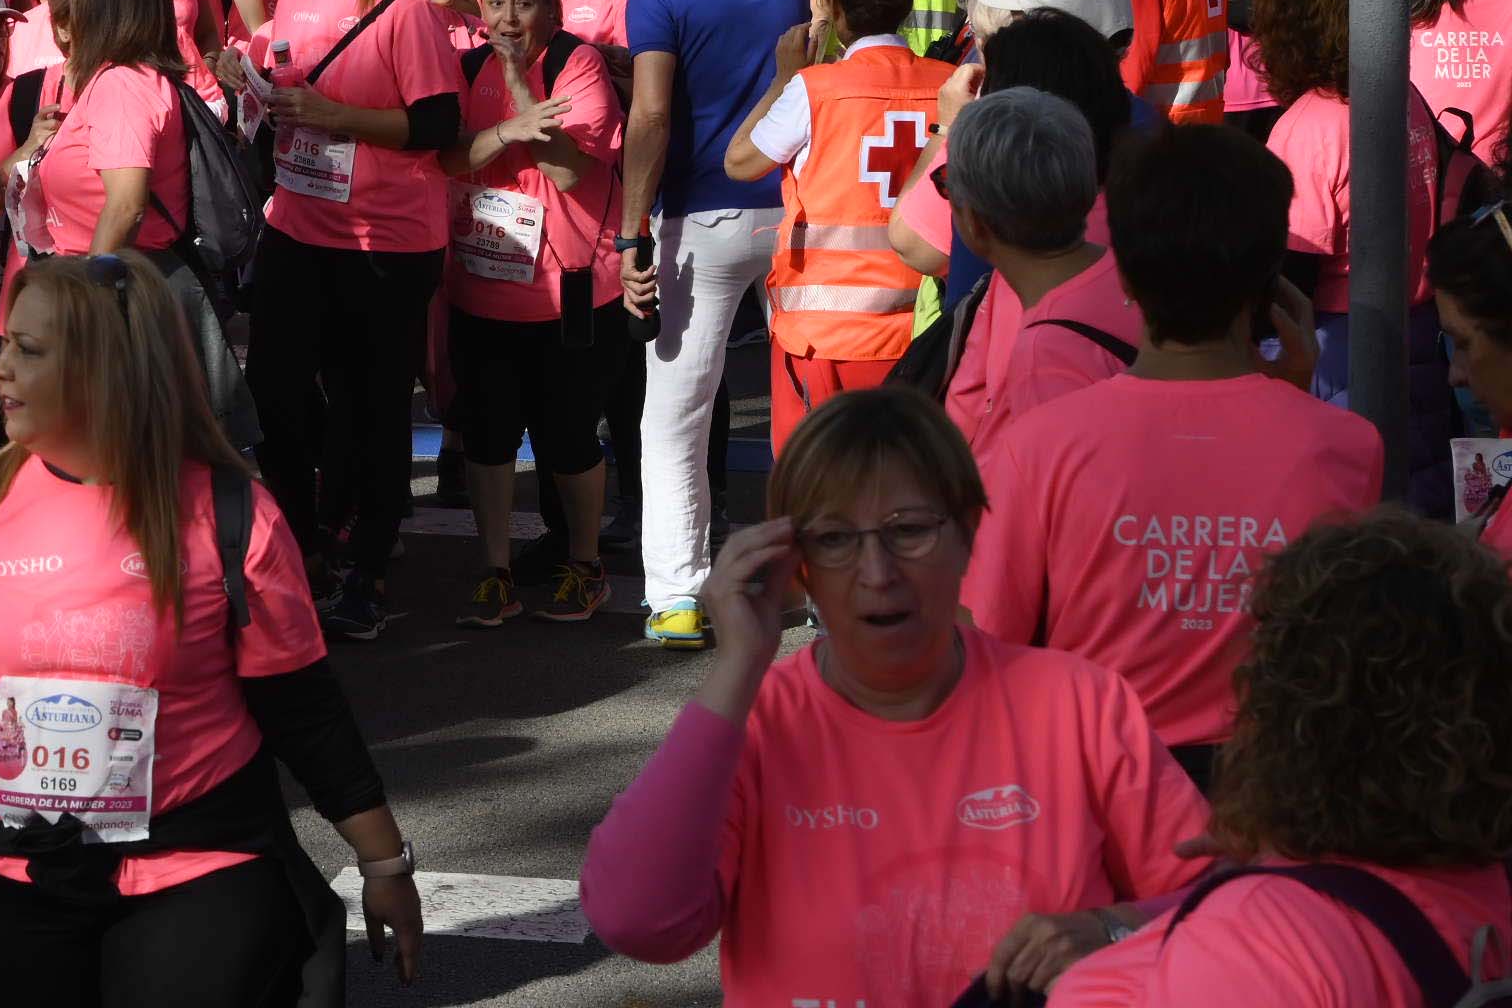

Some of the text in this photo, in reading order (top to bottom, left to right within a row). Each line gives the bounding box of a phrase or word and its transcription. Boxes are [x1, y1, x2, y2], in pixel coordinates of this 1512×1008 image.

[1420, 32, 1504, 47] CARRERA
[1437, 48, 1488, 63] DE LA
[1434, 64, 1492, 80] MUJER
[293, 138, 320, 156] 016
[475, 221, 506, 239] 016
[1113, 514, 1288, 548] CARRERA
[1147, 548, 1251, 580] DE LA
[1137, 581, 1253, 613] MUJER
[31, 707, 96, 725] ASTURIANA
[109, 706, 143, 717] SUMA
[32, 745, 90, 770] 016
[40, 777, 77, 791] 6169
[1, 793, 134, 810] CARRERA DE LA MUJER 2023
[85, 819, 135, 832] antander
[784, 804, 879, 830] OYSHO
